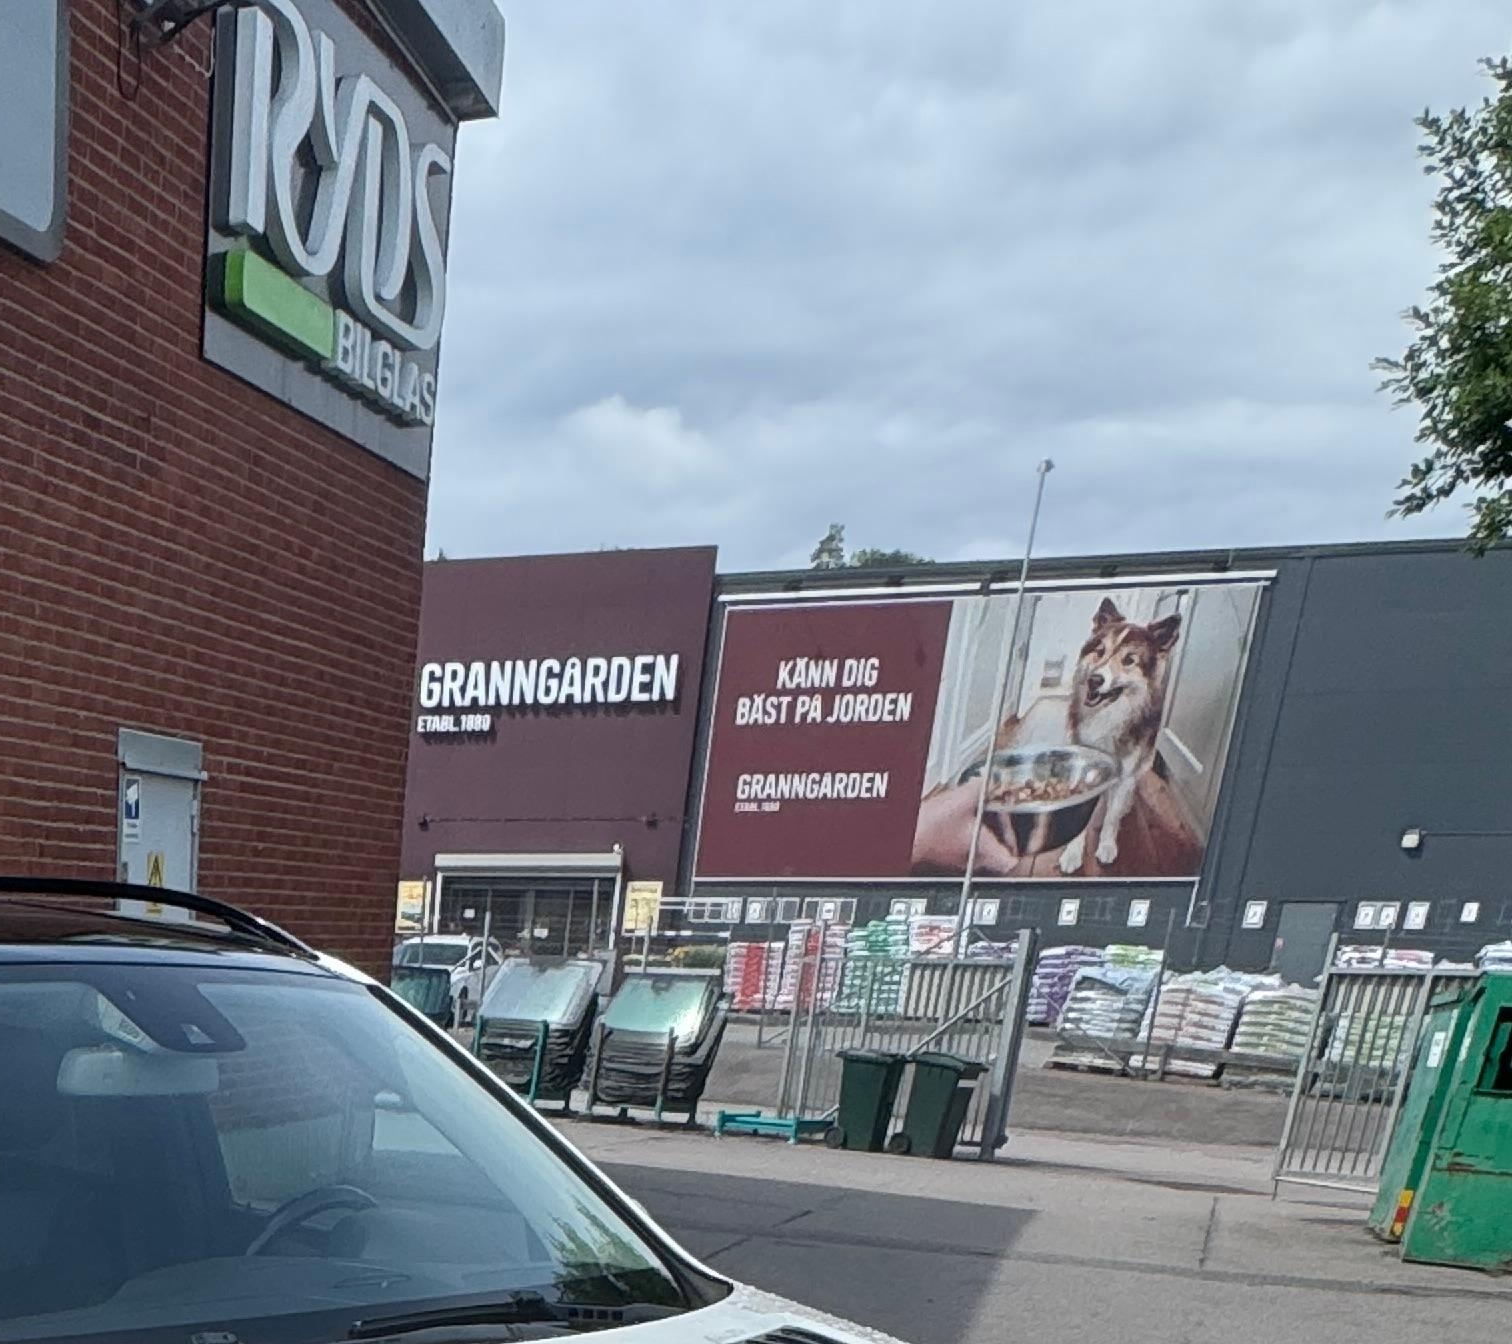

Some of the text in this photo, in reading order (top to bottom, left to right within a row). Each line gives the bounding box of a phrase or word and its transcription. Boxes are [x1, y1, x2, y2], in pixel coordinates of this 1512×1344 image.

[230, 0, 450, 350] RYDS
[335, 309, 436, 427] BILGLAS
[419, 653, 679, 708] GRANNGÅRDEN
[776, 656, 880, 689] KÄNN DIG
[735, 692, 913, 725] BÄST PÅ JORDEN
